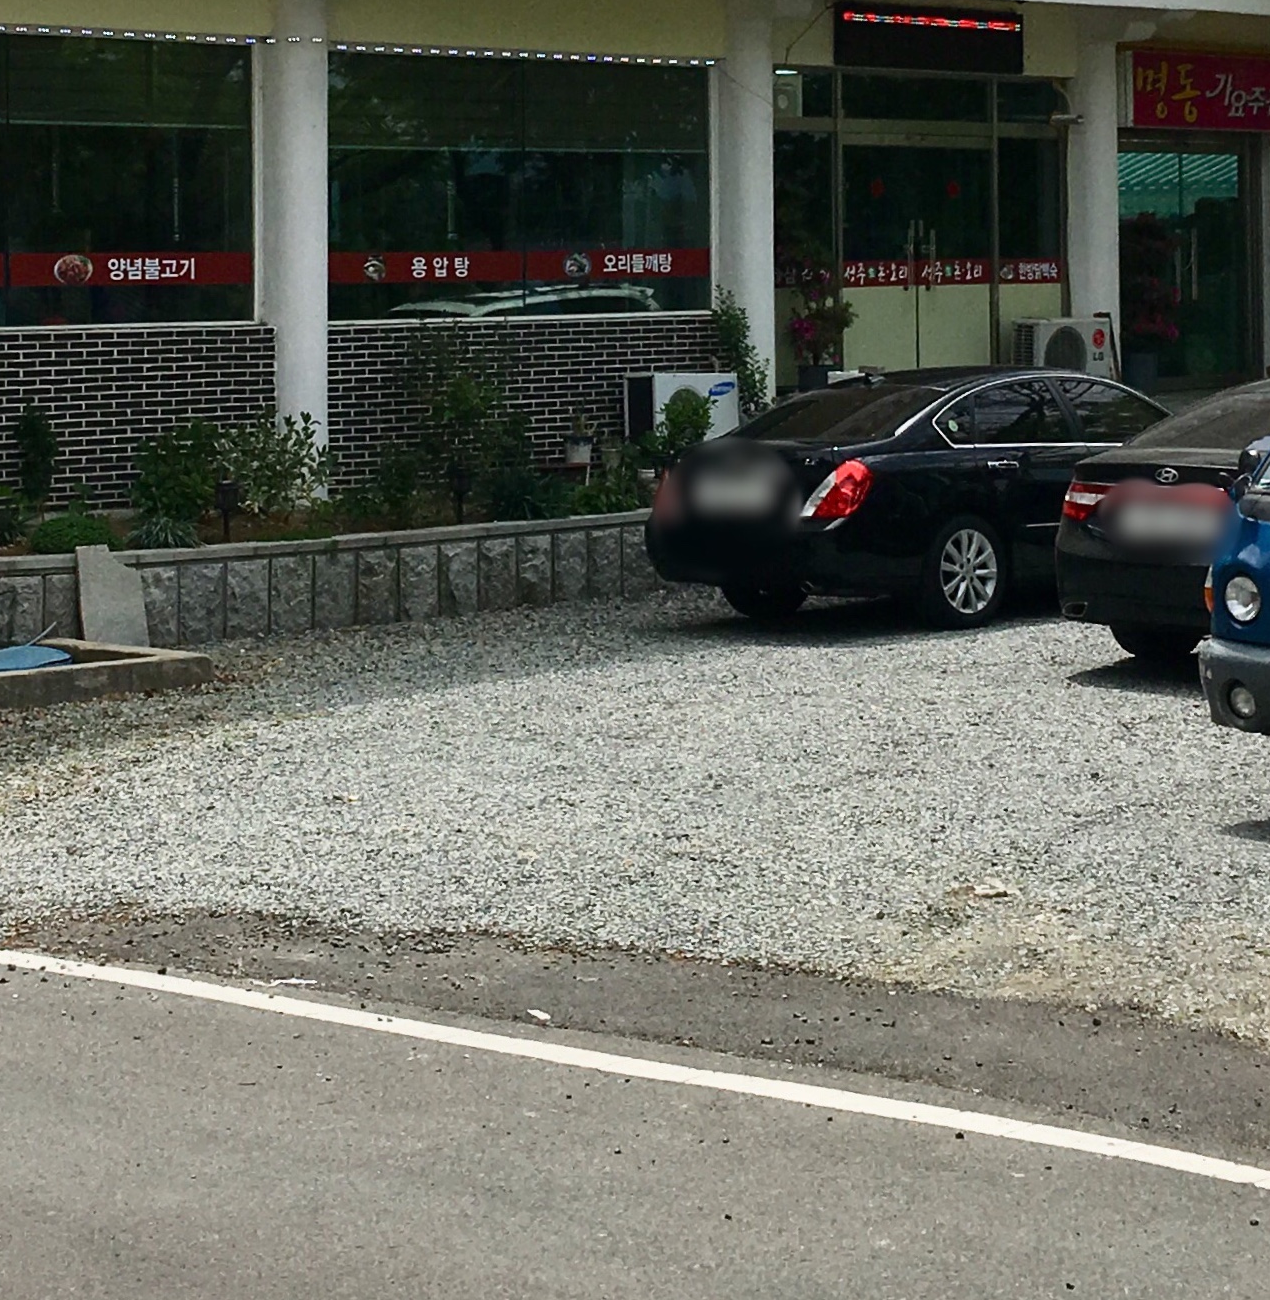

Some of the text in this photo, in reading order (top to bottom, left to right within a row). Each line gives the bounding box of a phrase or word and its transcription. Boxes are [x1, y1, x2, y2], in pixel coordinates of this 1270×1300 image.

[1136, 61, 1201, 123] 명동
[108, 257, 196, 281] 양념불고기
[603, 253, 672, 274] 오리들깨탕
